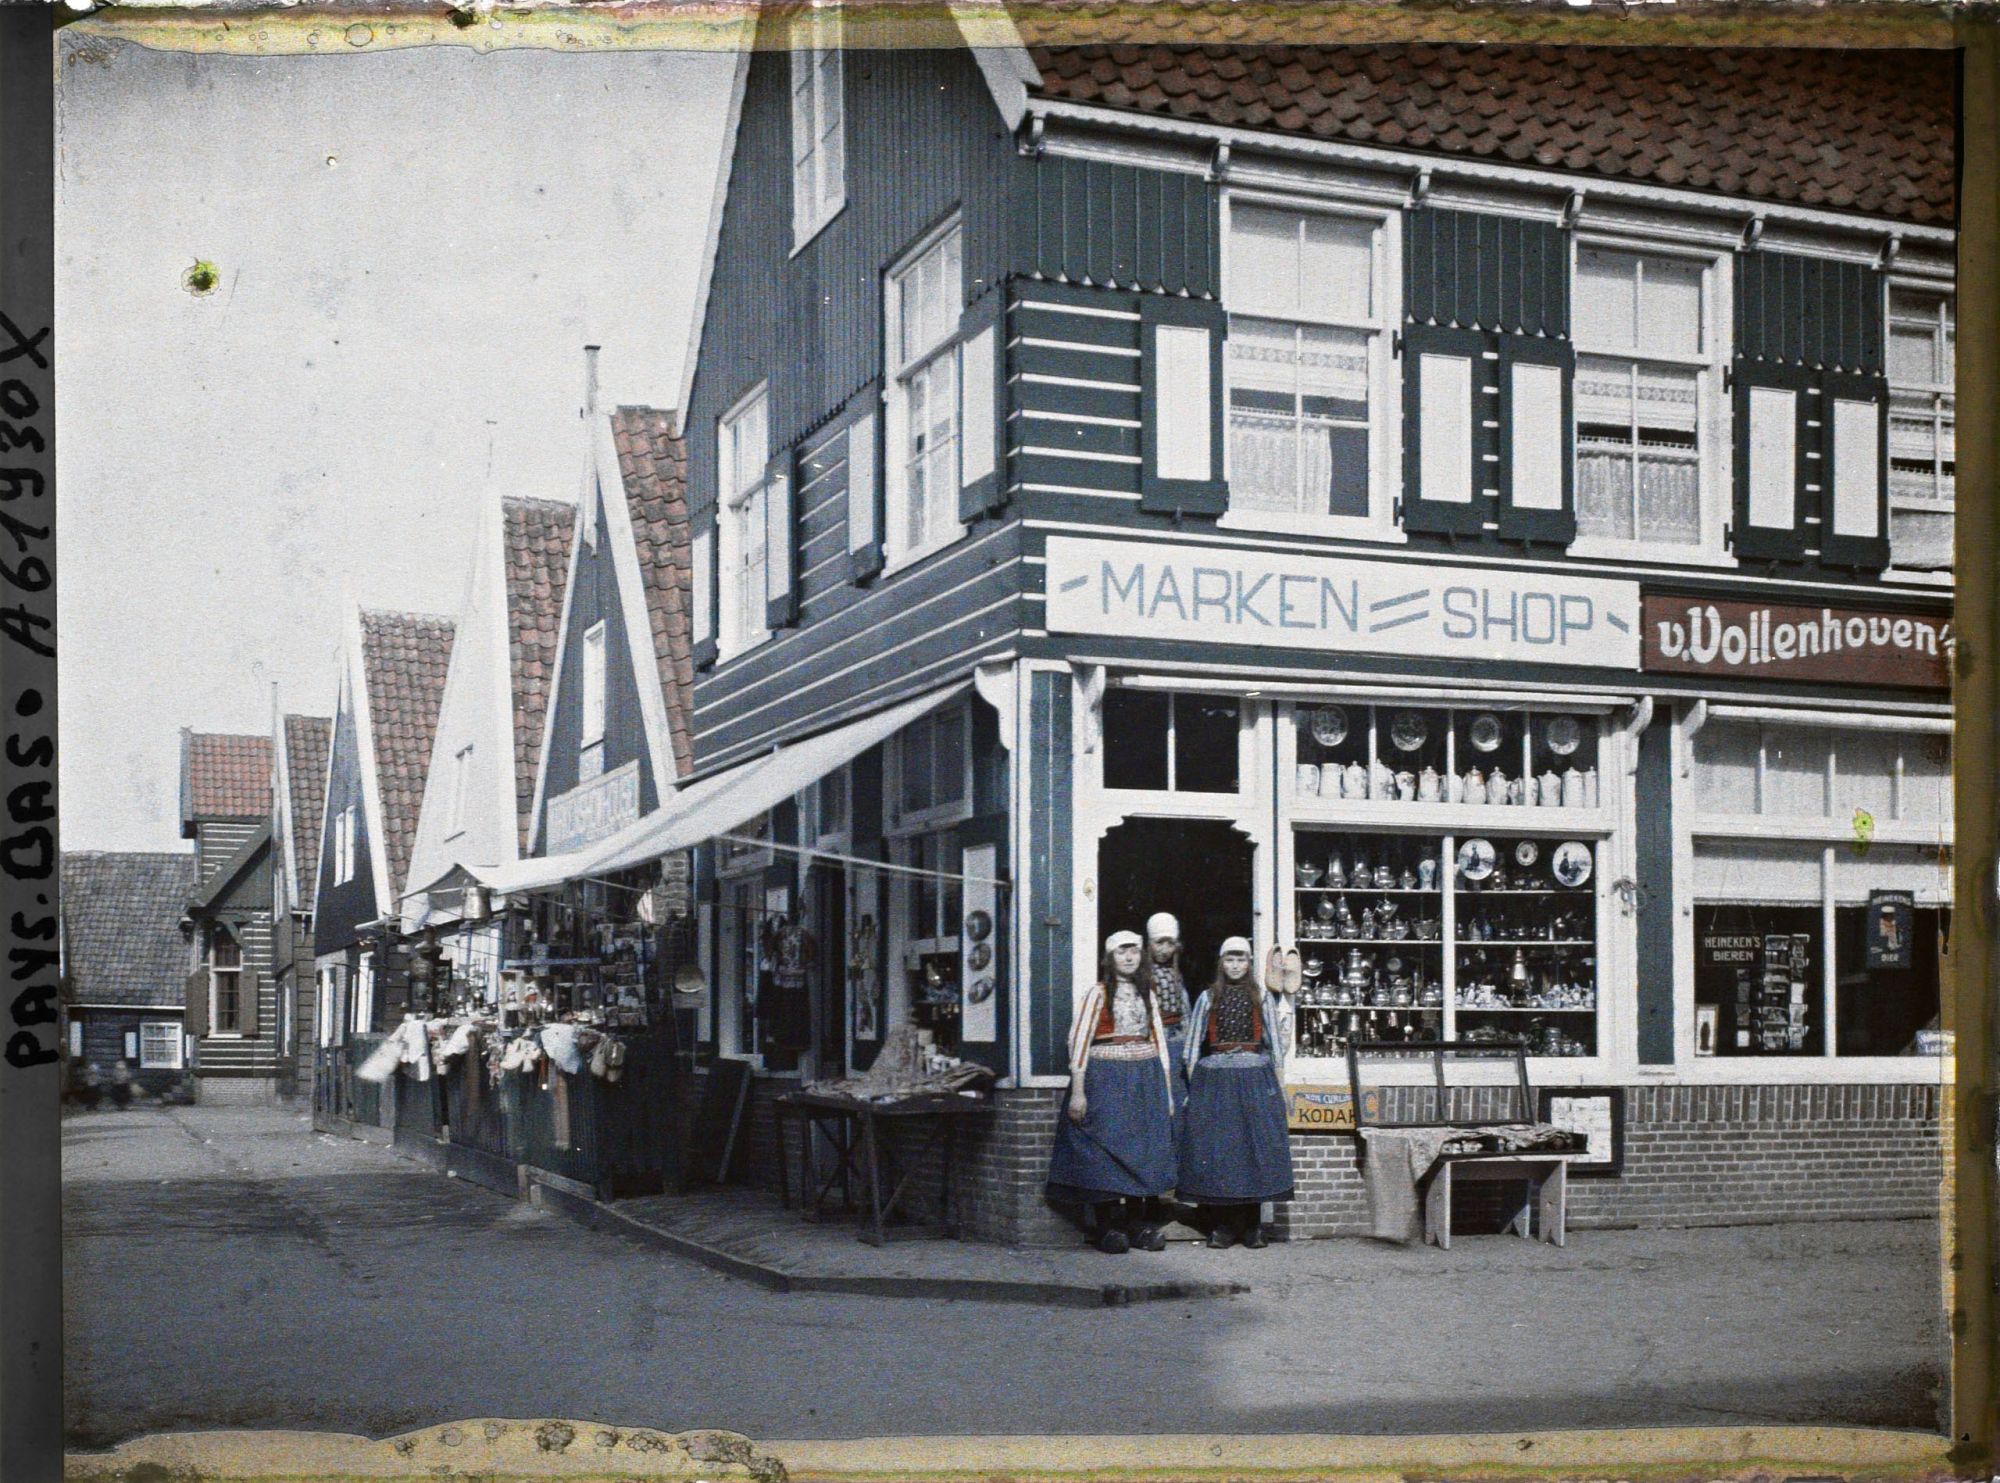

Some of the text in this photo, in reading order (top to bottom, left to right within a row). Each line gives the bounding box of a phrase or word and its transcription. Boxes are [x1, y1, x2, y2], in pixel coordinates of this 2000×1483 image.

[1100, 560, 1594, 646] MARKEN SHOP
[1704, 936, 1761, 948] HEINEKEN'S
[1712, 950, 1754, 961] BIEREN
